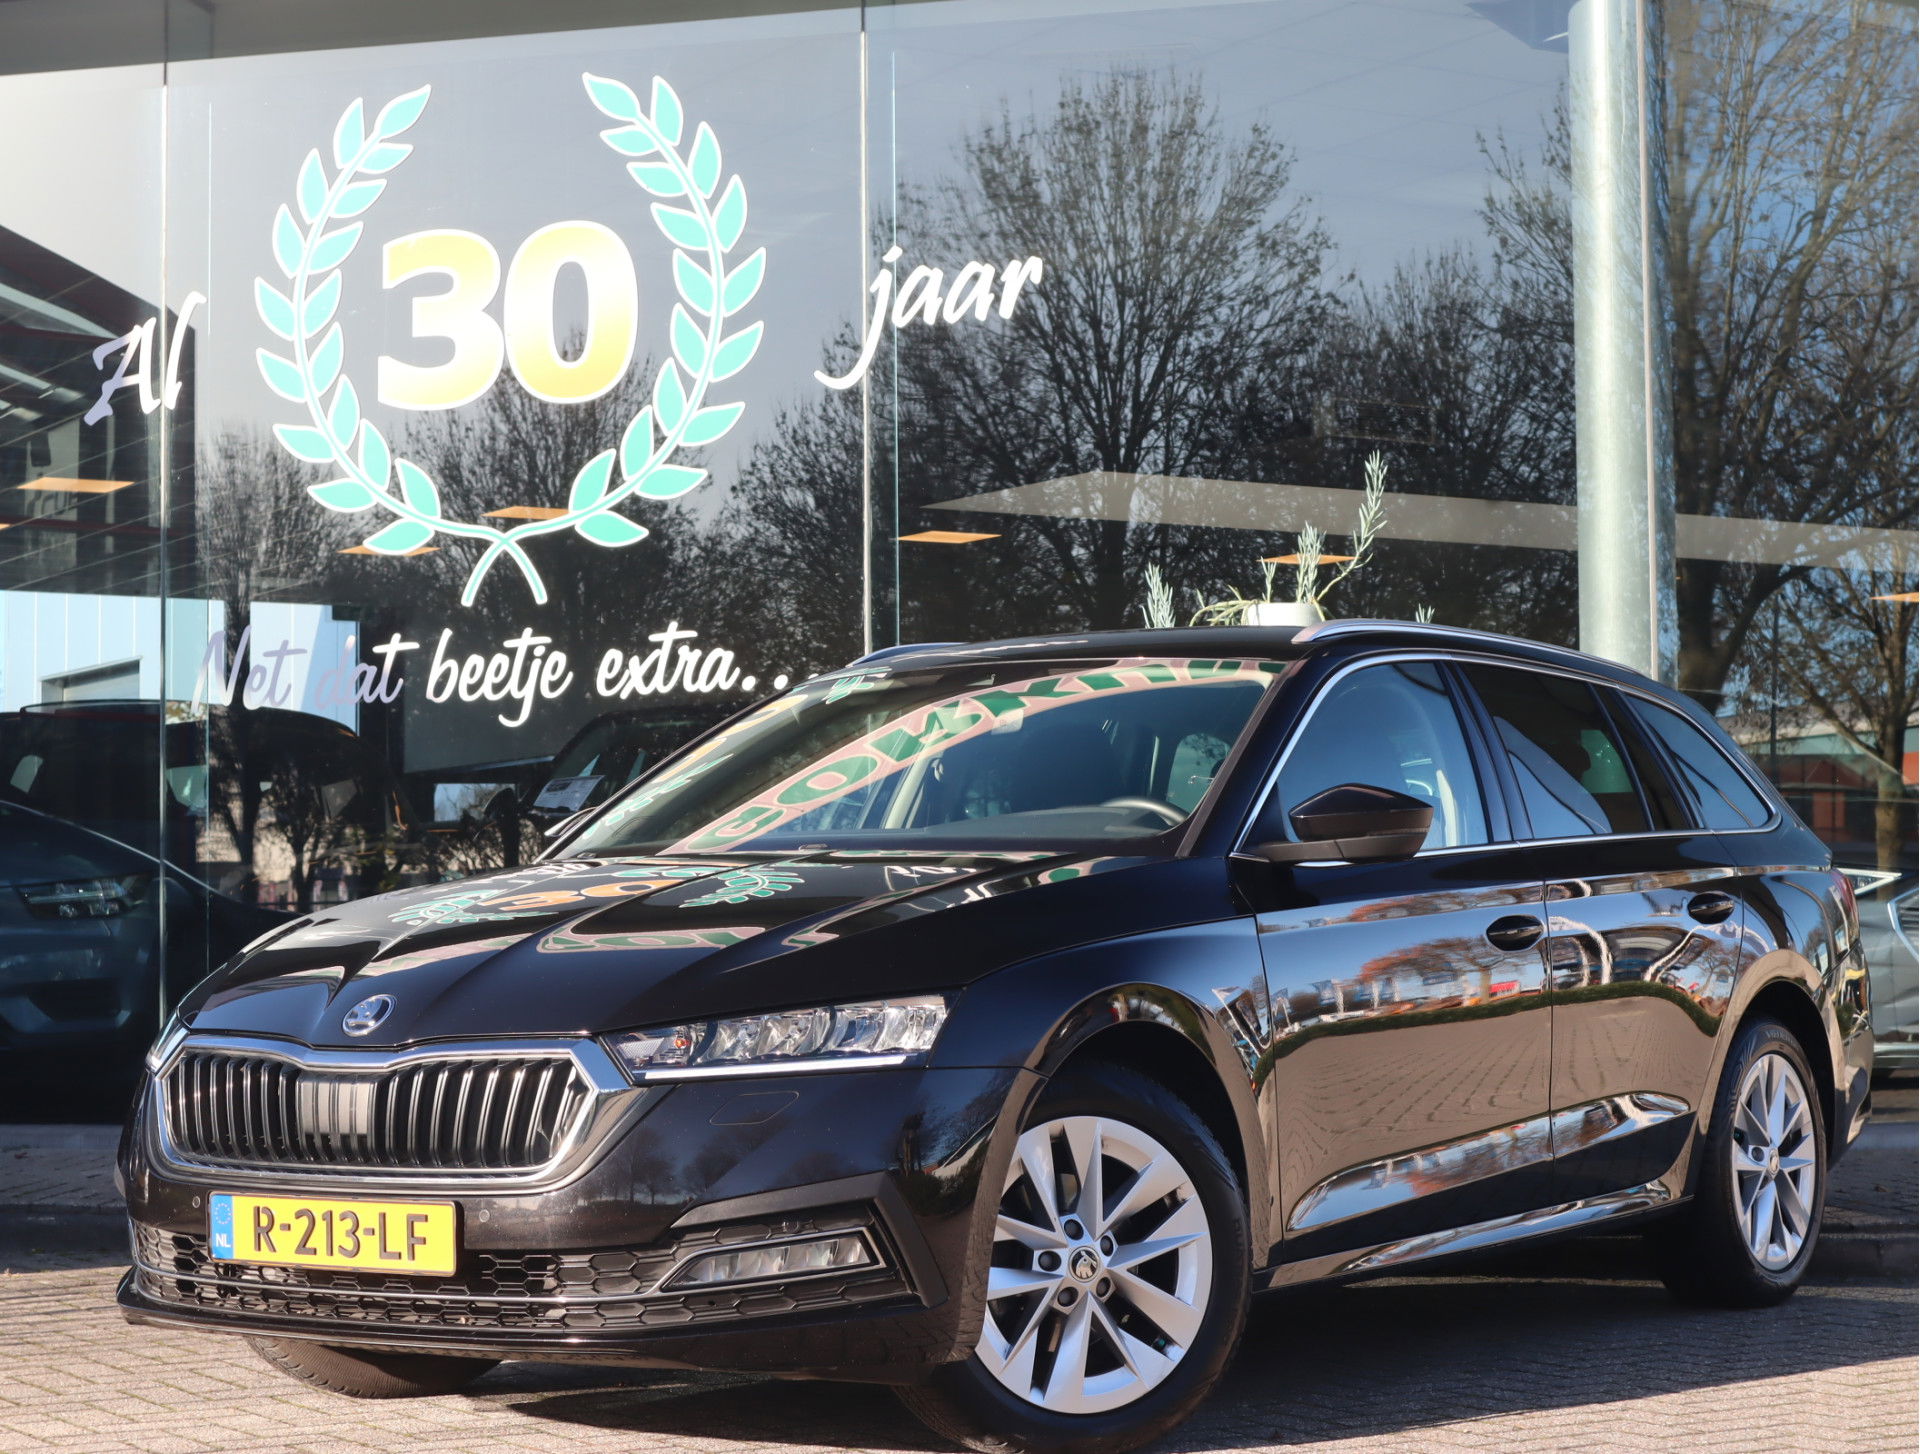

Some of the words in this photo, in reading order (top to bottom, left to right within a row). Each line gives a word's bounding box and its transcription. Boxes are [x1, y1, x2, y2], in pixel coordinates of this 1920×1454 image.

[84, 291, 207, 425] Al
[377, 220, 639, 411] 30
[814, 246, 1042, 390] jaar
[190, 624, 308, 716] Net
[314, 630, 420, 709] dat
[426, 627, 574, 729] beetje
[215, 1232, 232, 1249] NL
[252, 1205, 429, 1262] R-213-LF
